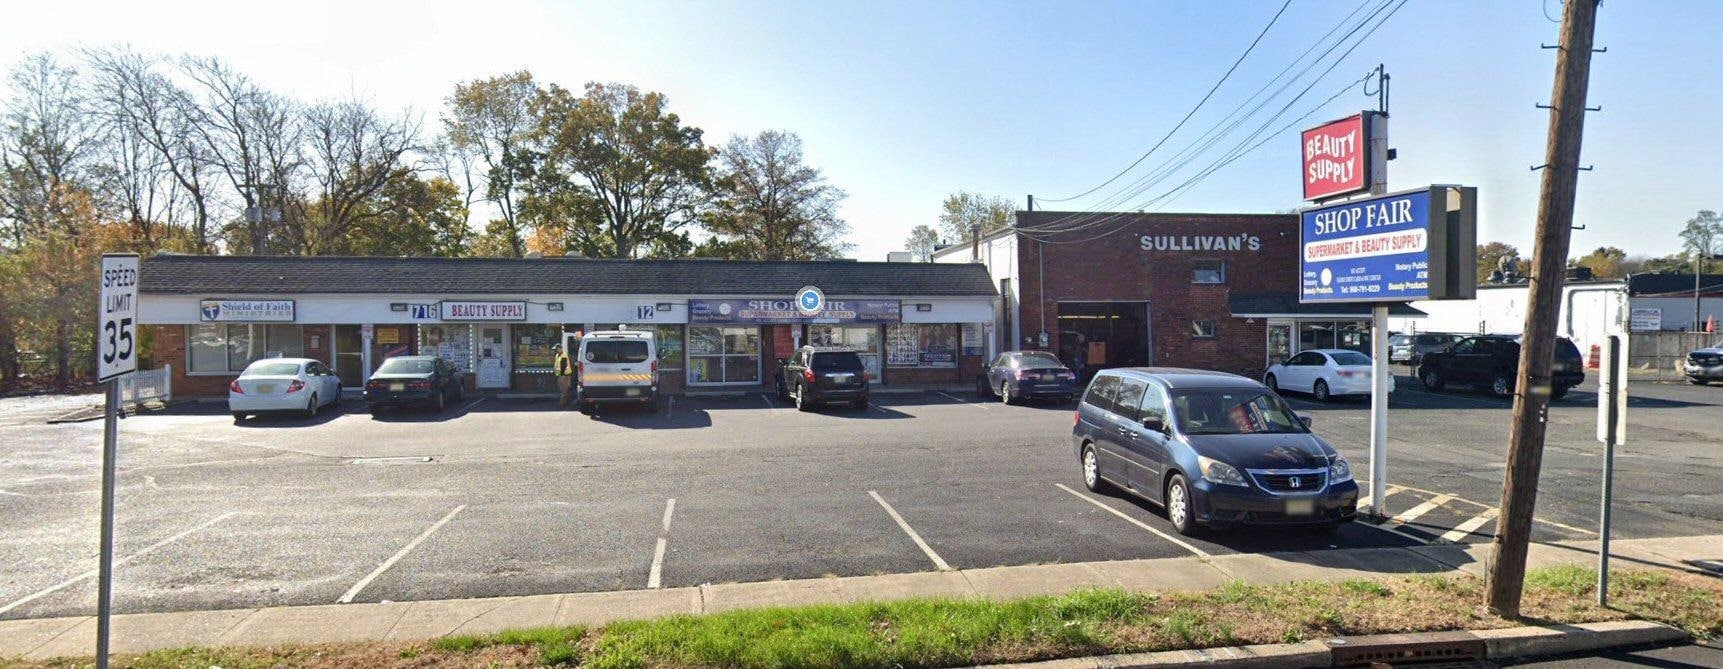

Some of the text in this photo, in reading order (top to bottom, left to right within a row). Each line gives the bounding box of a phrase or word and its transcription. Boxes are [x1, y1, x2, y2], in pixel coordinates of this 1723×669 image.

[1306, 129, 1356, 161] BEAUTY
[1309, 156, 1355, 184] SUPPLY
[1315, 199, 1413, 235] SHOP FAIR
[1140, 233, 1260, 251] SULLIVAN'S
[1308, 233, 1422, 258] SUPERMARKET & BEAUTY SUPPLY
[104, 269, 136, 288] SPEED
[107, 294, 131, 313] LIMIT
[222, 302, 291, 311] Shield of Faith
[411, 305, 437, 318] 716
[451, 304, 523, 317] BEAUTY SUPPLY
[104, 318, 132, 364] 35
